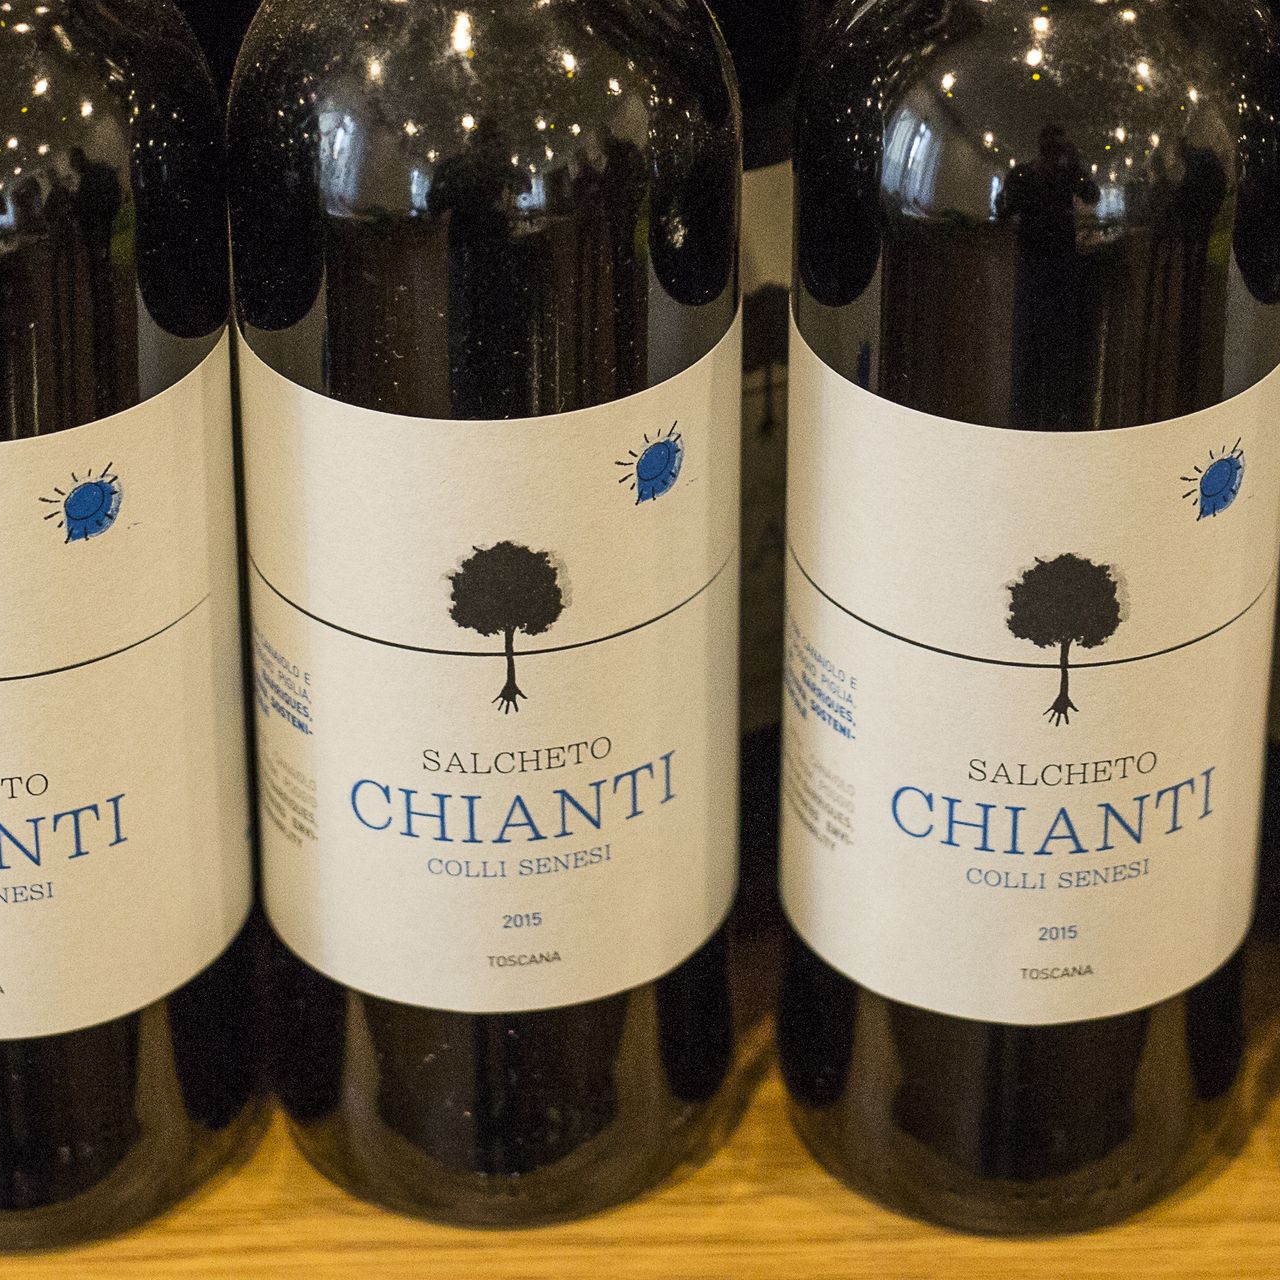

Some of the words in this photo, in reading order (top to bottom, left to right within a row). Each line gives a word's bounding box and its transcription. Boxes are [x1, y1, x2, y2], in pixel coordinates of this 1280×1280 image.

[422, 735, 612, 774] SALCHETO
[968, 750, 1158, 787] SALCHETO
[351, 751, 676, 844] CHIANTI
[891, 767, 1215, 856] CHIANTI
[427, 857, 507, 879] COLLI
[518, 845, 612, 877] SENESI
[965, 867, 1047, 890] COLLI
[1057, 858, 1150, 890] SENESI
[502, 911, 543, 930] 2015
[1038, 924, 1078, 942] 2015
[486, 950, 562, 968] TOSCANA
[1020, 964, 1094, 980] TOSCANA
